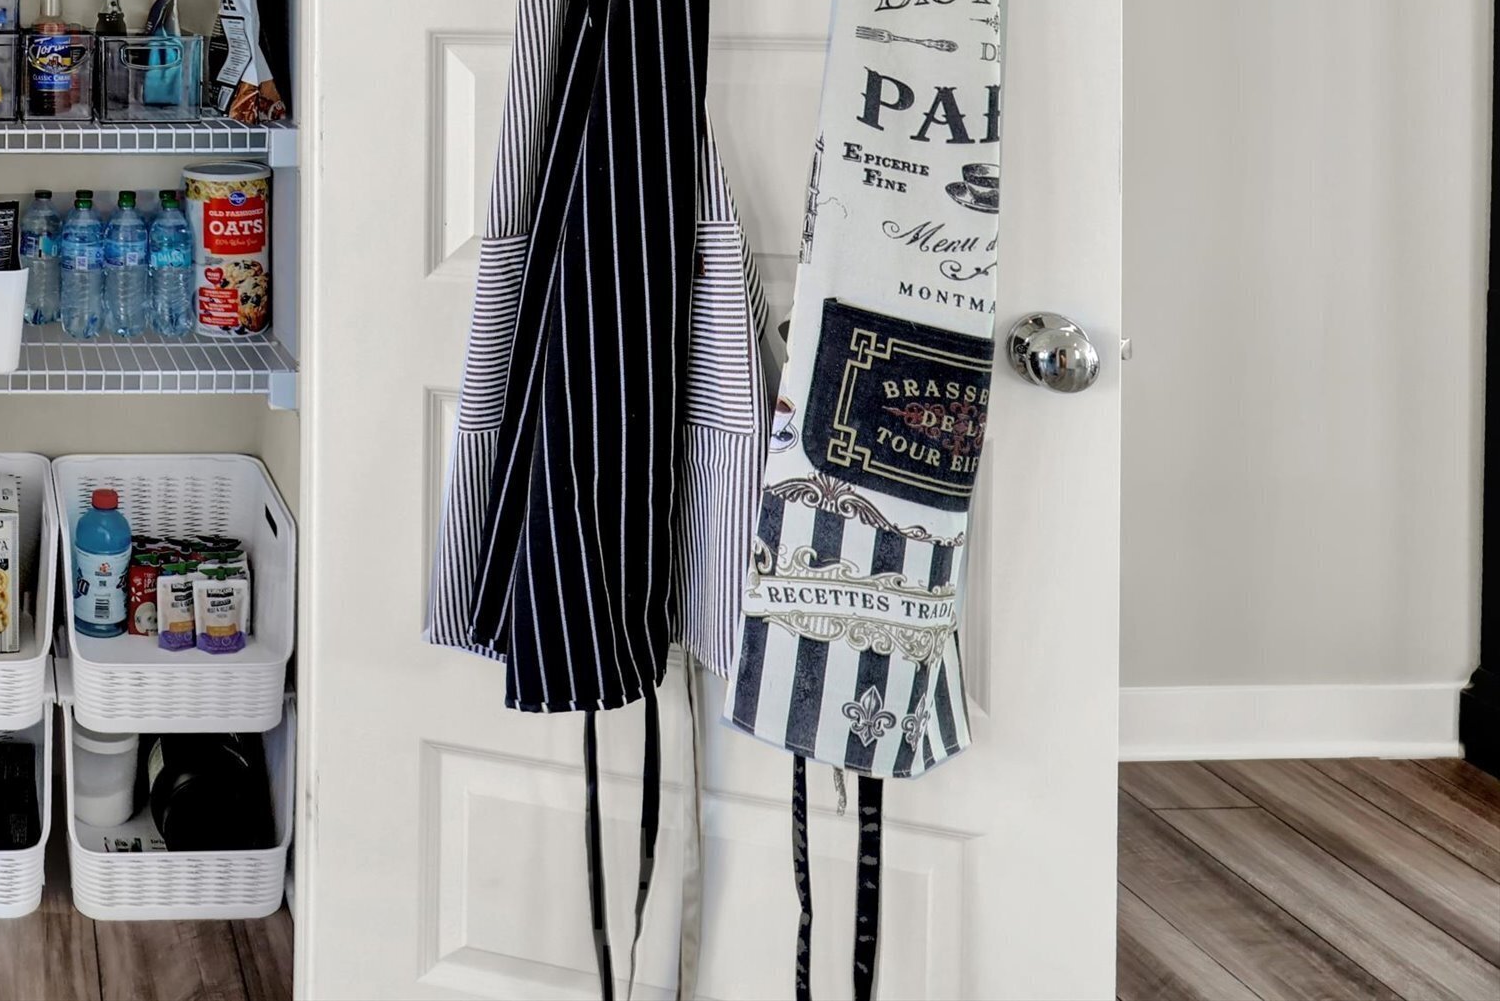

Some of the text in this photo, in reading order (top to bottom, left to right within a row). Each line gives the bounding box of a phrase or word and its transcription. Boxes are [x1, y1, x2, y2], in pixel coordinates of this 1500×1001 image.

[842, 142, 929, 177] EPICERIE
[863, 168, 907, 193] FINE
[209, 219, 263, 236] OATS
[882, 220, 980, 253] Menu
[921, 409, 955, 433] DE
[876, 426, 941, 467] TOUR
[767, 586, 890, 612] RECETTES
